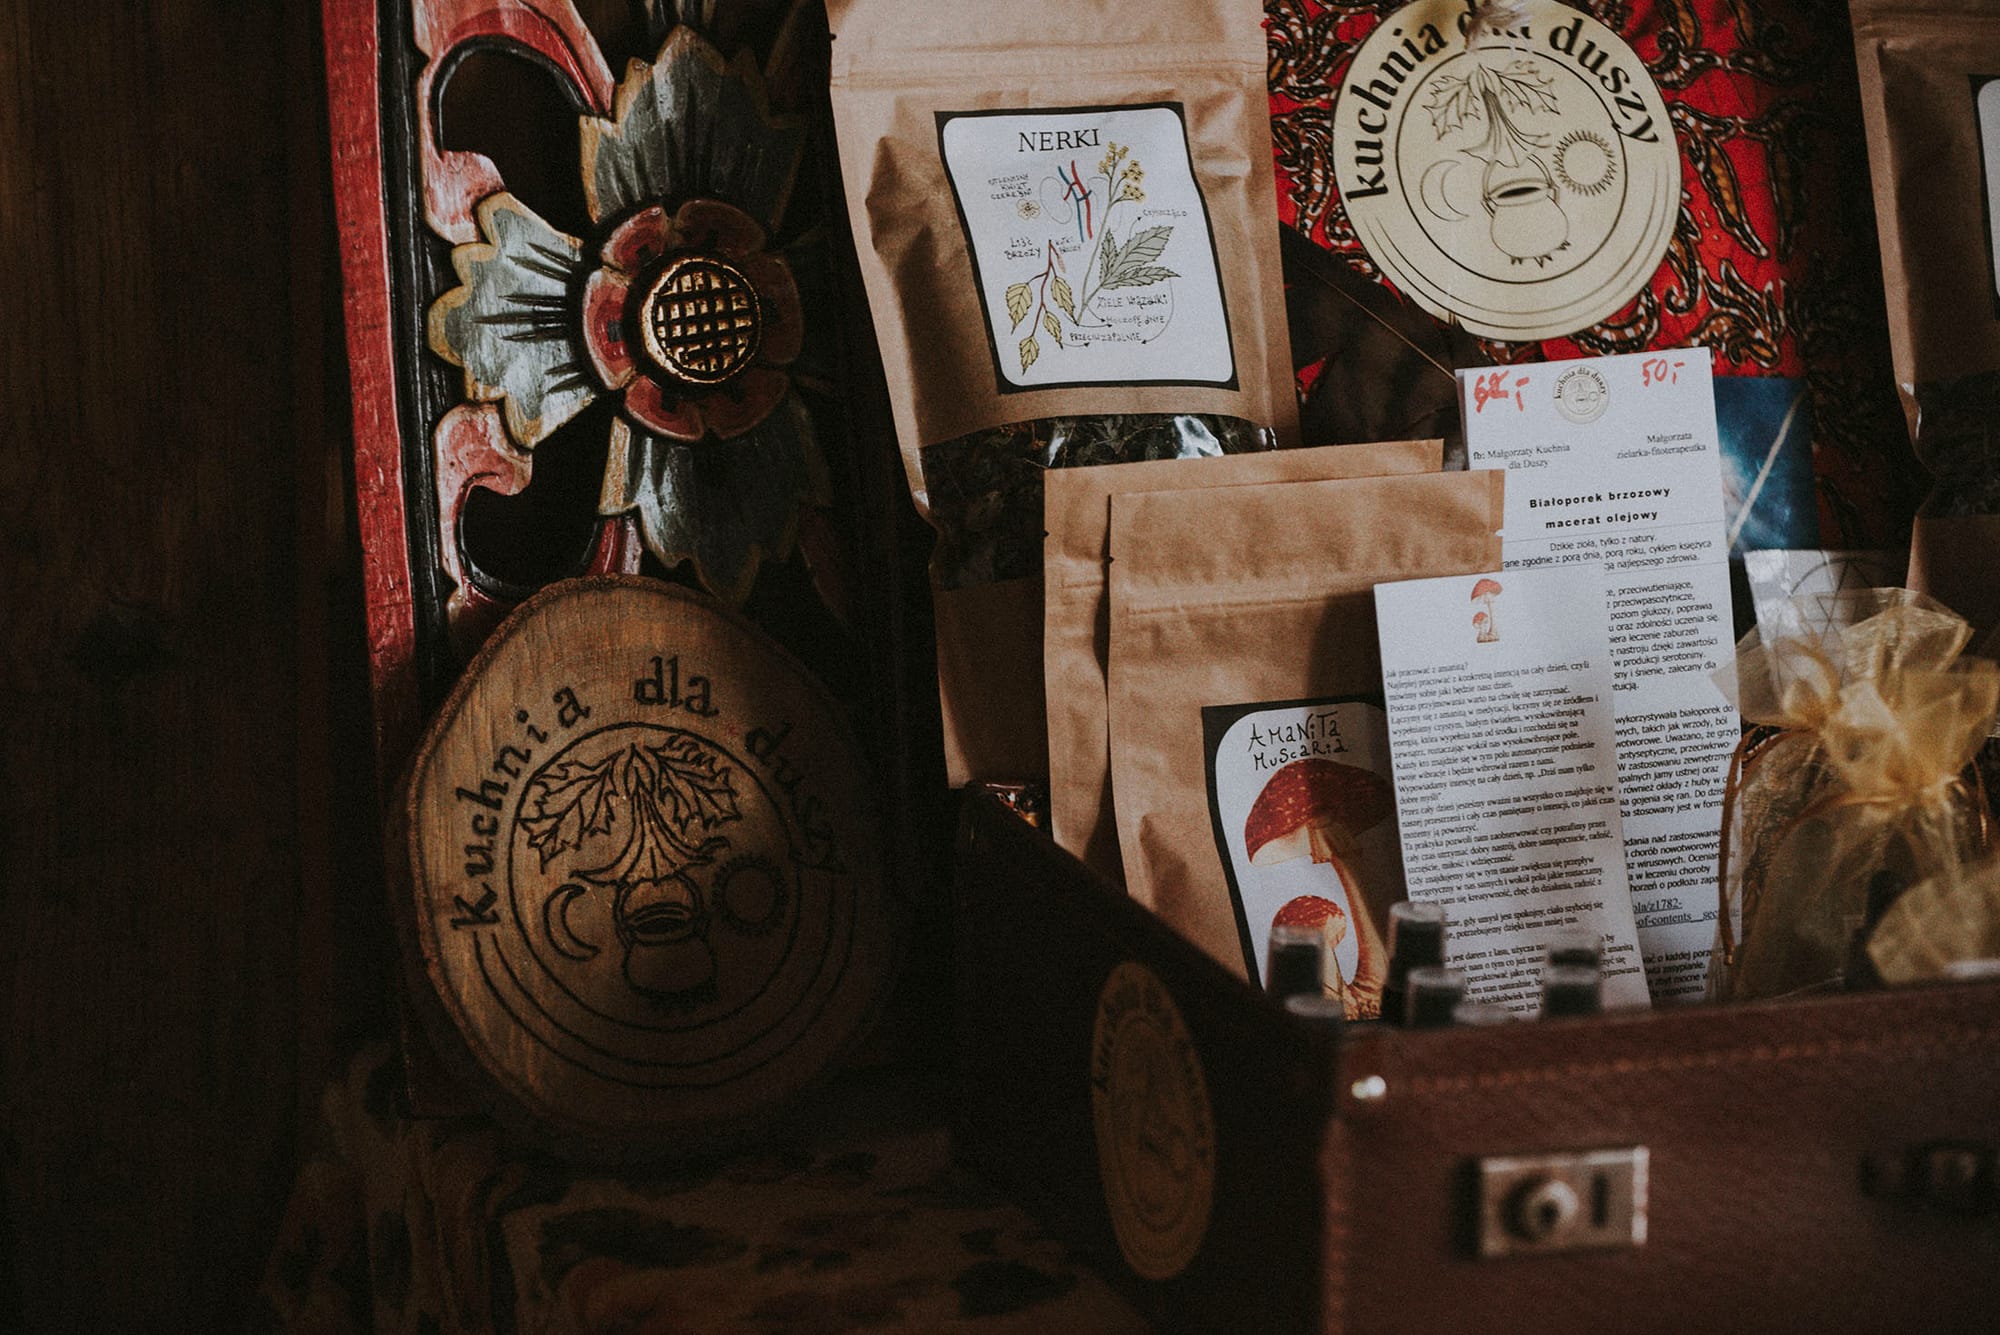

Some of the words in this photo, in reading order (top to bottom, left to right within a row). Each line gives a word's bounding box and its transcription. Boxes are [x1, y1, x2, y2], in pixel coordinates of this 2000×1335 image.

[1345, 20, 1449, 202] kuchnia
[1548, 17, 1660, 146] duszy
[1018, 128, 1101, 153] NERKI
[1529, 492, 1602, 507] Białoporek
[1608, 488, 1670, 500] brzozowy
[1545, 515, 1600, 528] macerat
[1606, 511, 1658, 522] olejowy
[634, 655, 719, 717] dla
